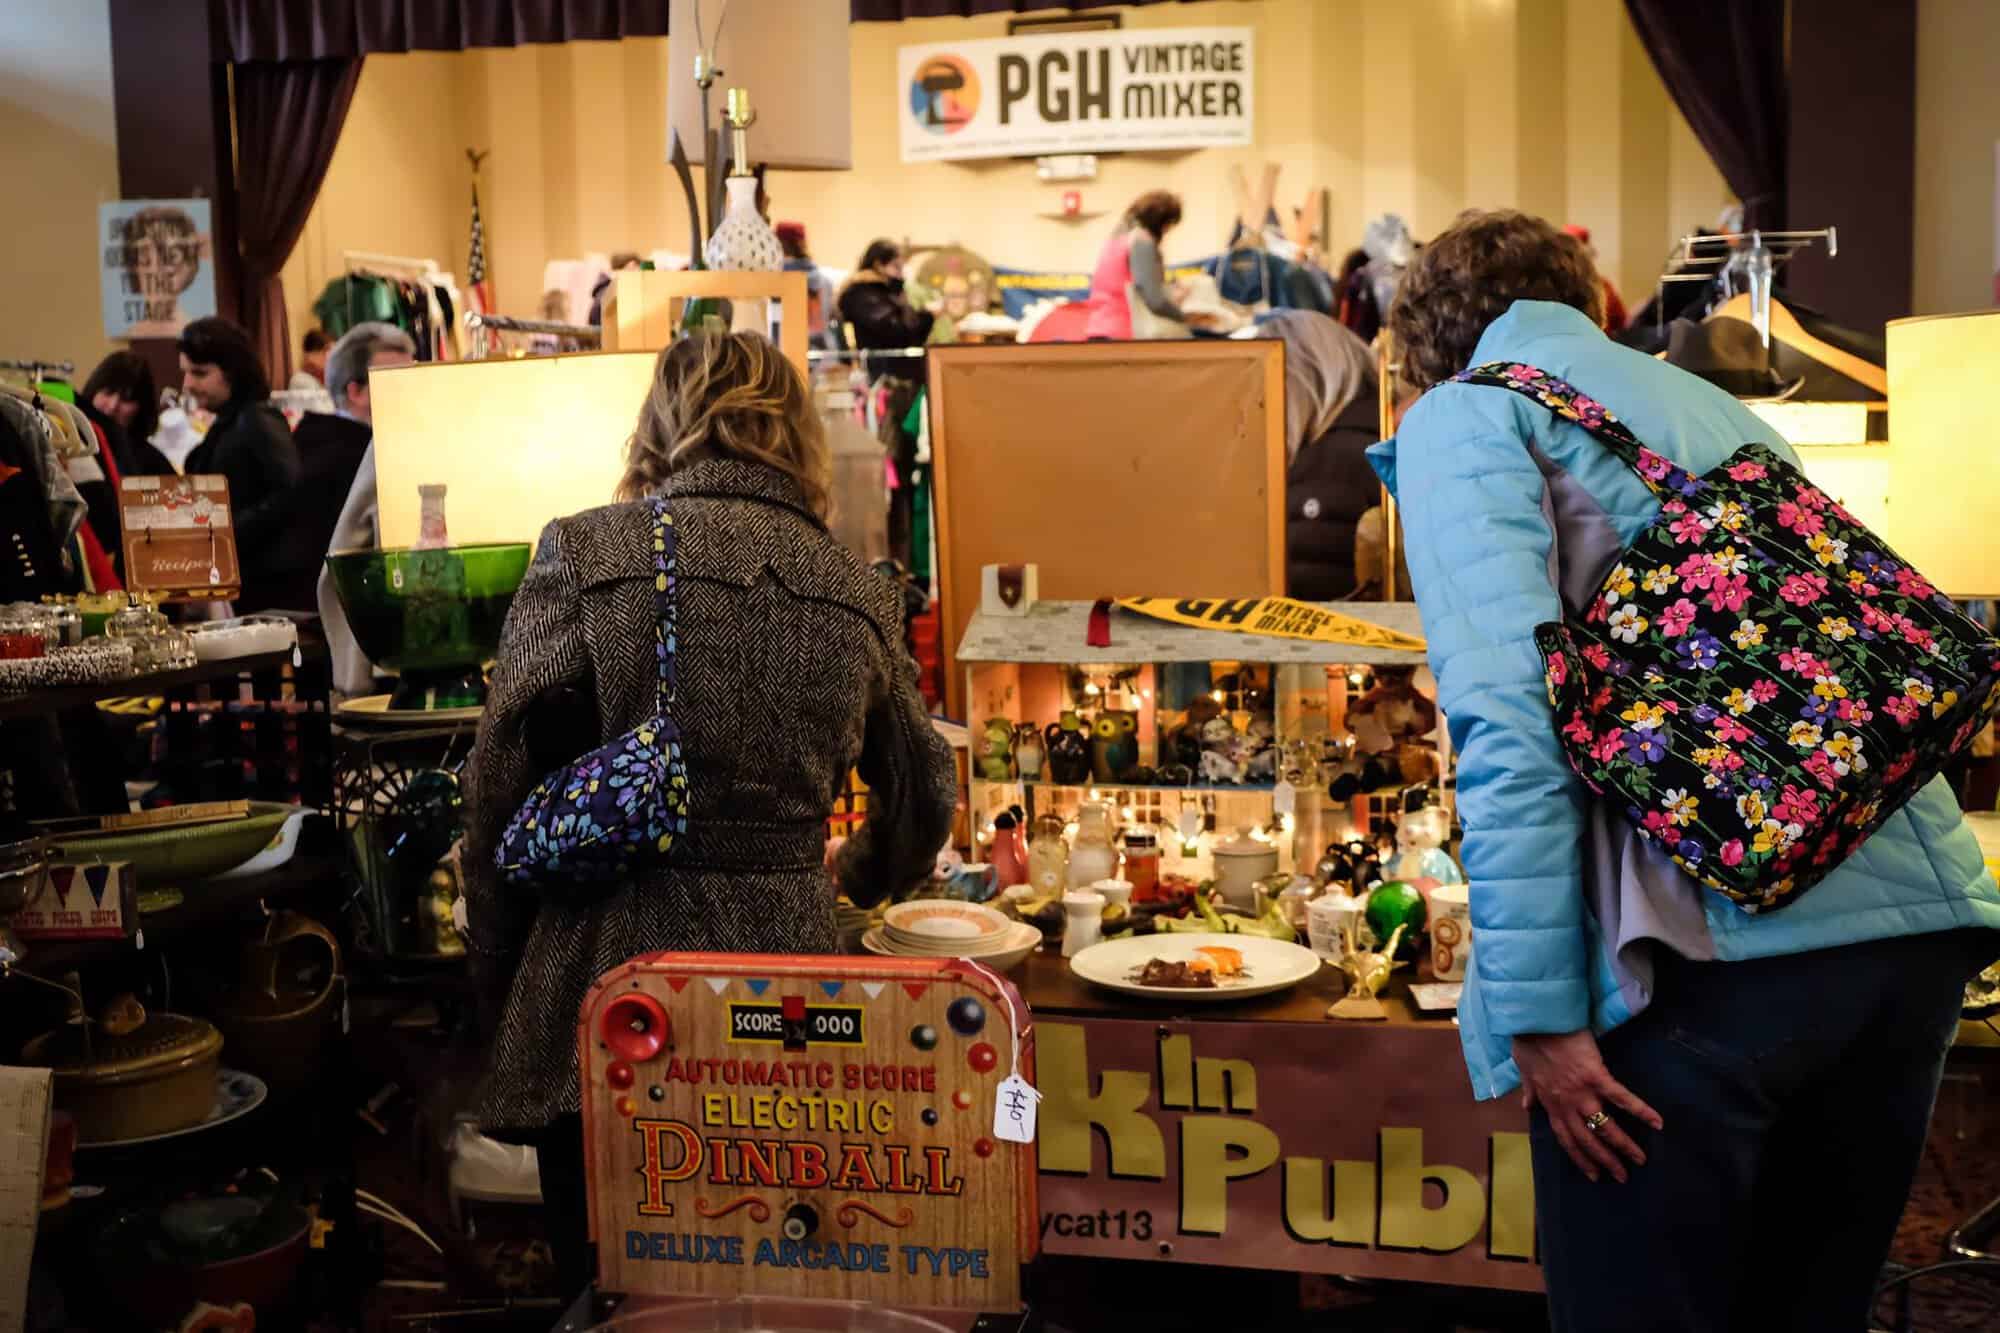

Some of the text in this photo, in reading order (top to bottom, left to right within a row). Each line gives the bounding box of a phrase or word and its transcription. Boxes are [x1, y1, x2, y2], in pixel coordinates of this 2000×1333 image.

[1123, 43, 1243, 74] VINTAGE
[996, 47, 1111, 125] PGH
[1123, 82, 1243, 119] MIXER
[123, 300, 176, 322] STAGE
[1253, 614, 1317, 636] MIXER
[1262, 599, 1337, 626] VINTAGE
[815, 1015, 854, 1035] 000
[665, 1056, 938, 1094] AUTOMATIC SCORE
[703, 1093, 896, 1134] ELECTRIC
[634, 1118, 965, 1217] PINBALL
[626, 1230, 990, 1279] DELUXE ARCADE TYPE
